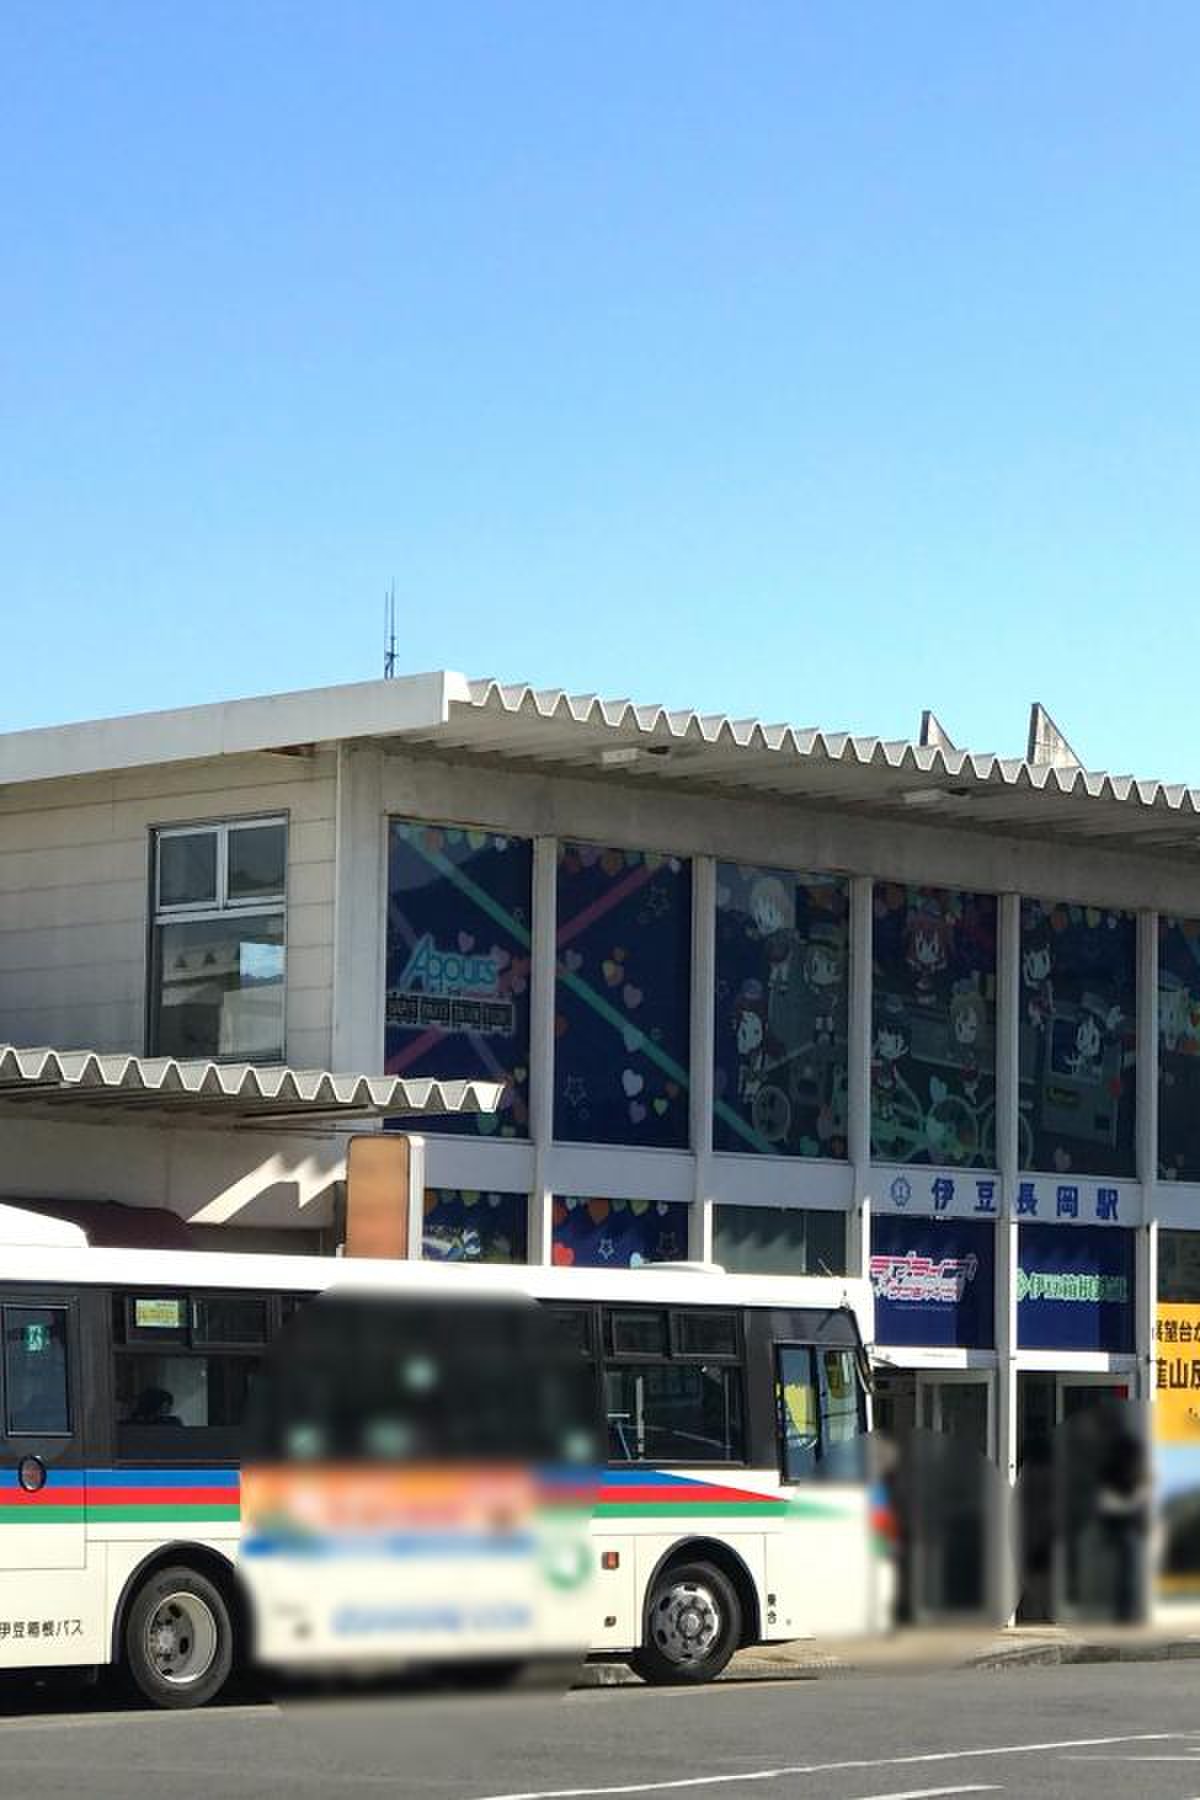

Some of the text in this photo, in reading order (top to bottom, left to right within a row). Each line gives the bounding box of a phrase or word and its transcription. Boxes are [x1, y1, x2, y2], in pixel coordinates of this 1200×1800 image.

[931, 1178, 1118, 1220] 伊豆長岡駅
